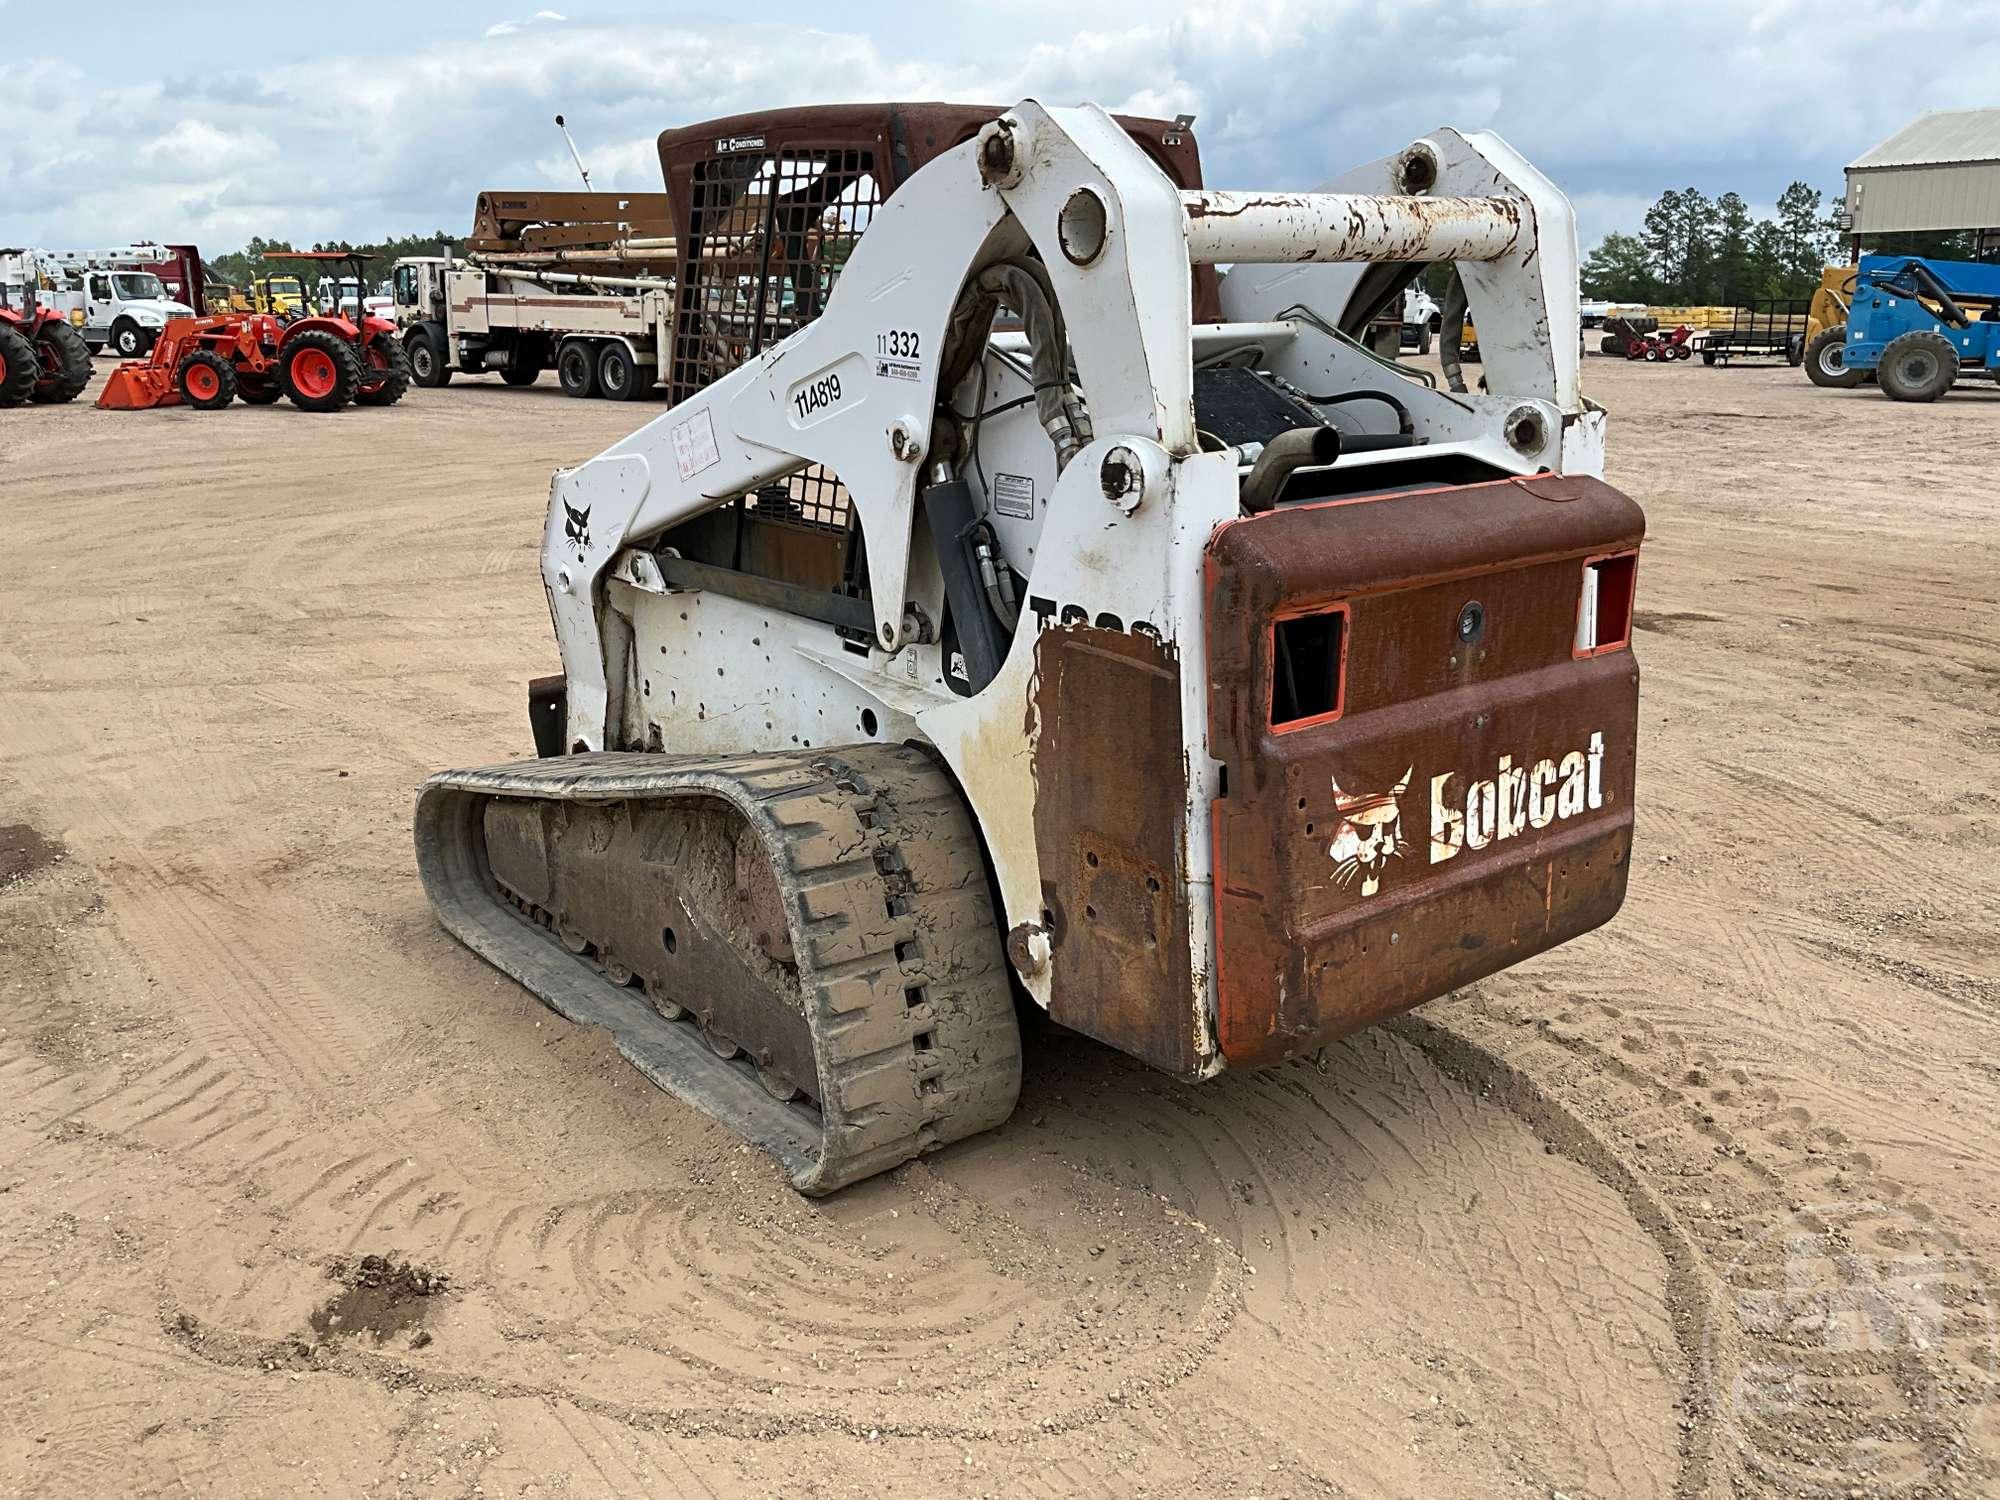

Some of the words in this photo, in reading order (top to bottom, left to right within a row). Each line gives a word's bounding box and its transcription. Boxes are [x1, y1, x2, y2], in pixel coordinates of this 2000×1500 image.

[889, 330, 920, 358] 332
[795, 374, 841, 418] 11A819
[1430, 731, 1604, 864] Bobcat
